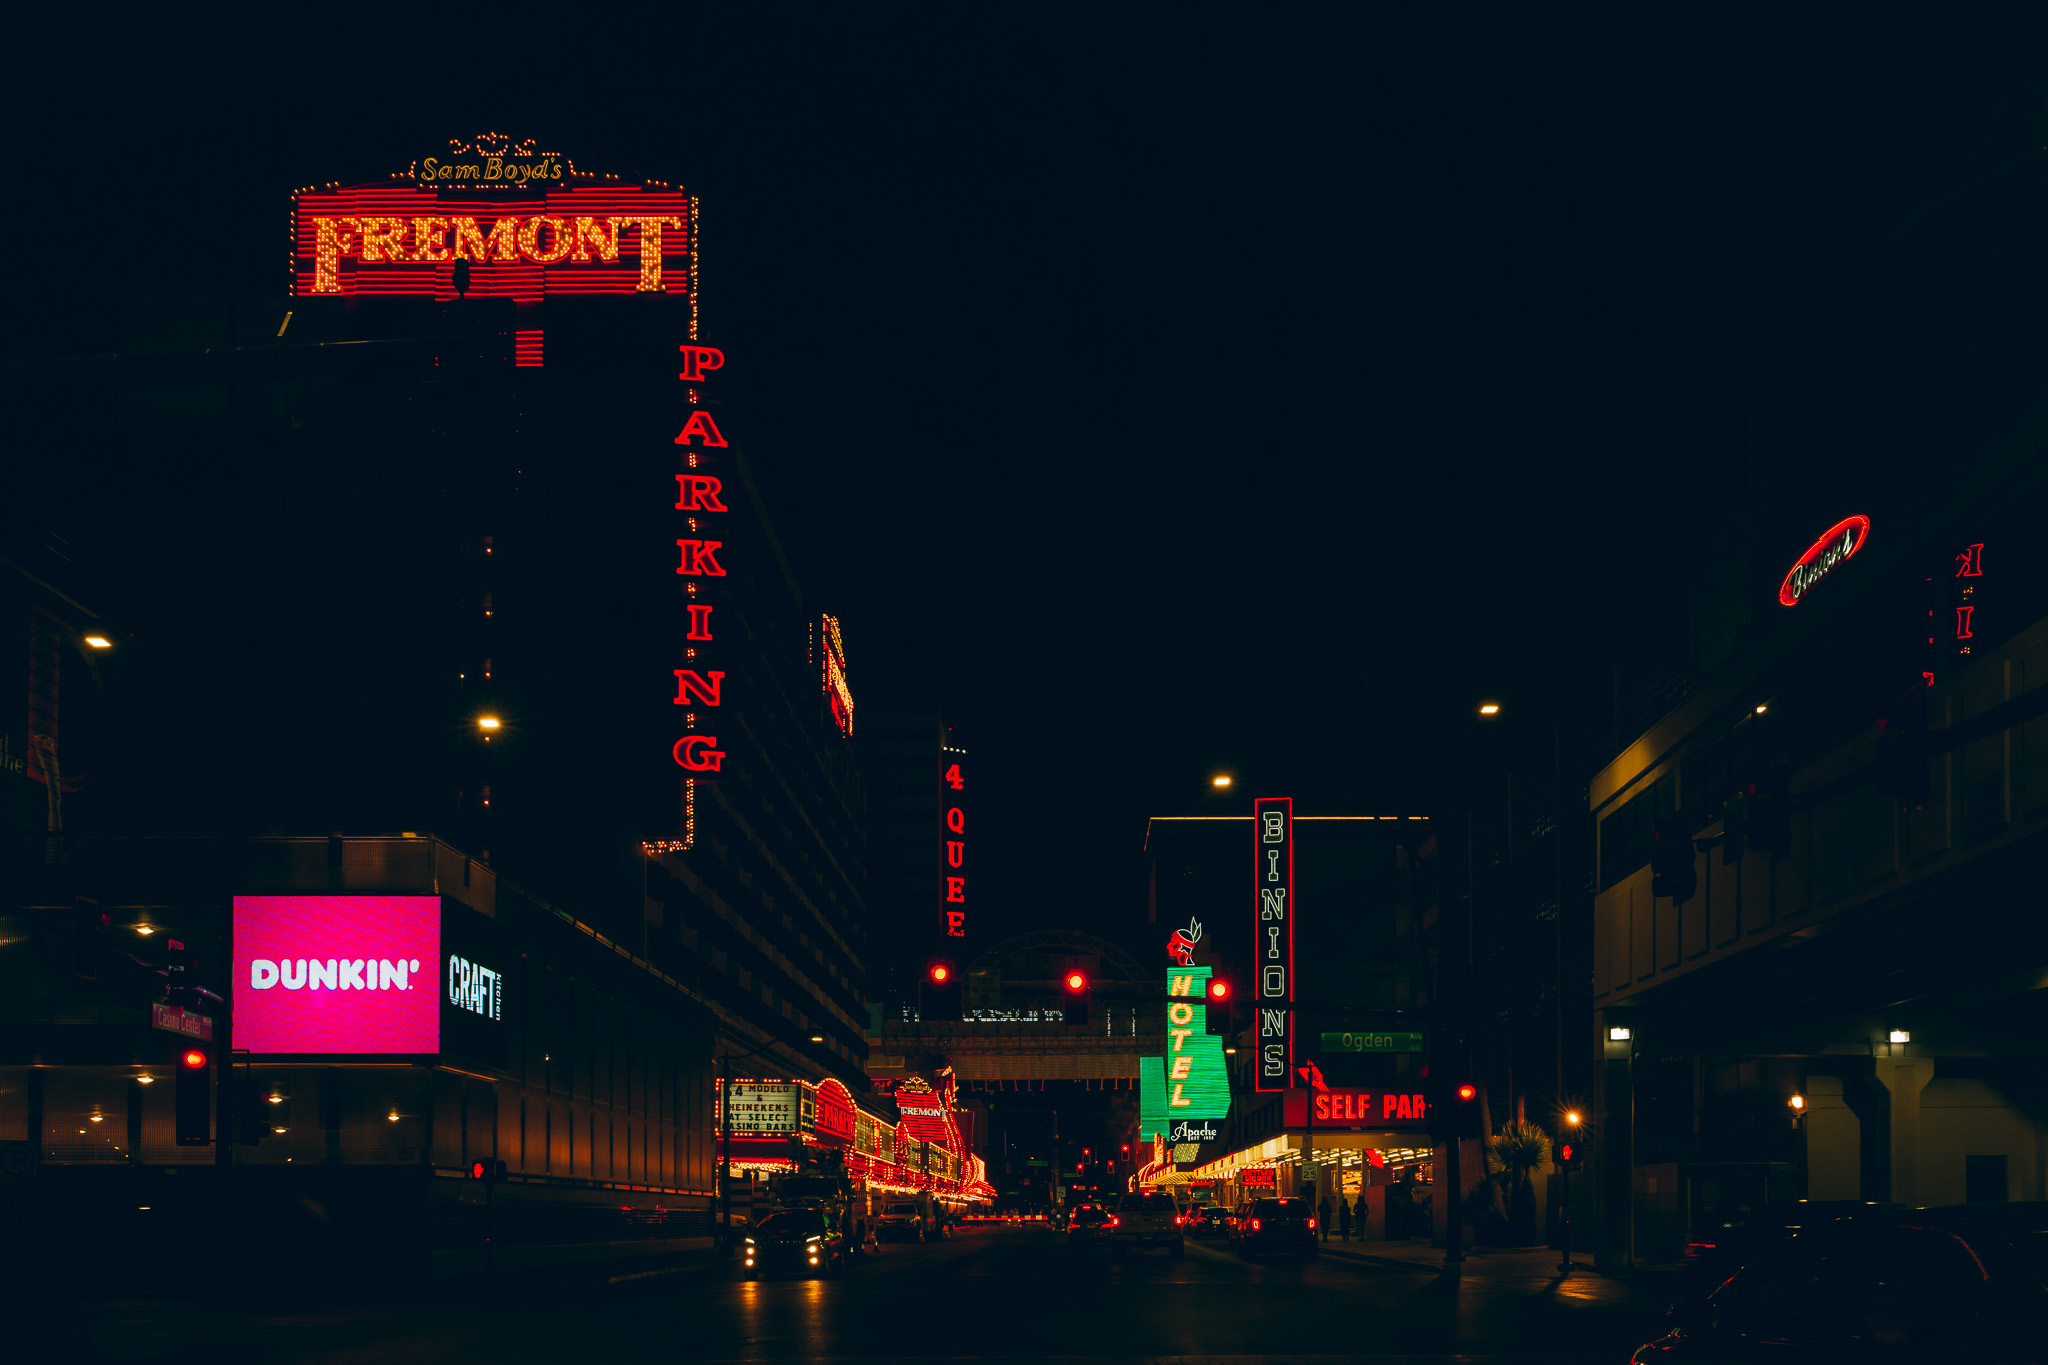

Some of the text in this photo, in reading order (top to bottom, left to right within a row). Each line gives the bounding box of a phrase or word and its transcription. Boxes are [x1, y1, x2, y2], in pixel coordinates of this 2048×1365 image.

[421, 156, 562, 184] Sam Boyd's
[311, 215, 683, 293] FREMONT
[673, 344, 728, 771] PARKING
[1788, 528, 1853, 599] Binion's
[946, 764, 965, 790] 4
[1262, 812, 1286, 1076] BINIONS
[449, 954, 496, 1018] CRAFT
[158, 1007, 180, 1030] Casino
[180, 1013, 201, 1036] Center
[1169, 975, 1193, 1106] HOTEL
[1342, 1033, 1393, 1052] Ogden
[748, 1085, 789, 1093] MODELO
[756, 1094, 763, 1102] &
[900, 1107, 948, 1121] FREMONT
[1316, 1094, 1370, 1119] SELF
[766, 1123, 794, 1131] BARS
[1170, 1121, 1217, 1141] Apache
